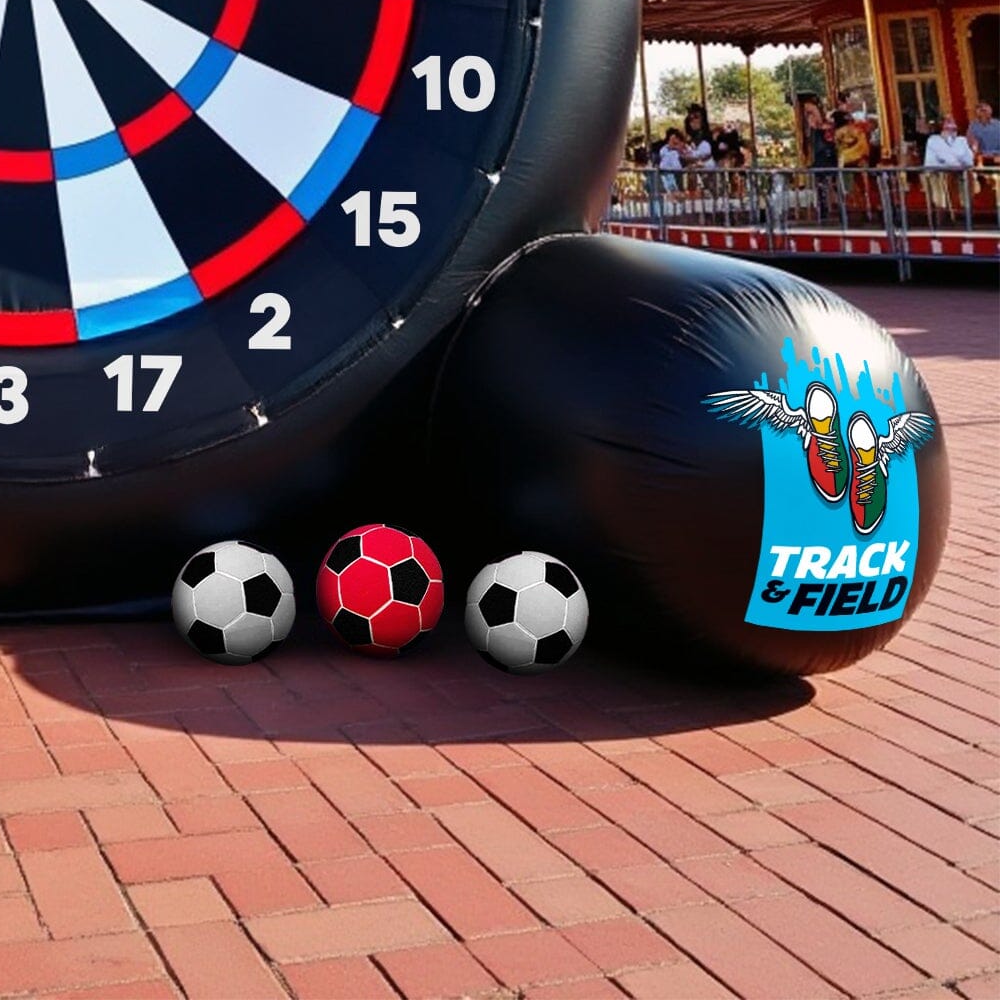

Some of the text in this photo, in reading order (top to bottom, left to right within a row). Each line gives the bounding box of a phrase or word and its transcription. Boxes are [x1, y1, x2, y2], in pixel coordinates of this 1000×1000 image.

[412, 56, 495, 112] 10
[341, 191, 420, 247] 15
[249, 293, 291, 349] 2
[104, 355, 182, 411] 17
[770, 540, 910, 579] TRACK
[787, 576, 908, 616] FIELD
